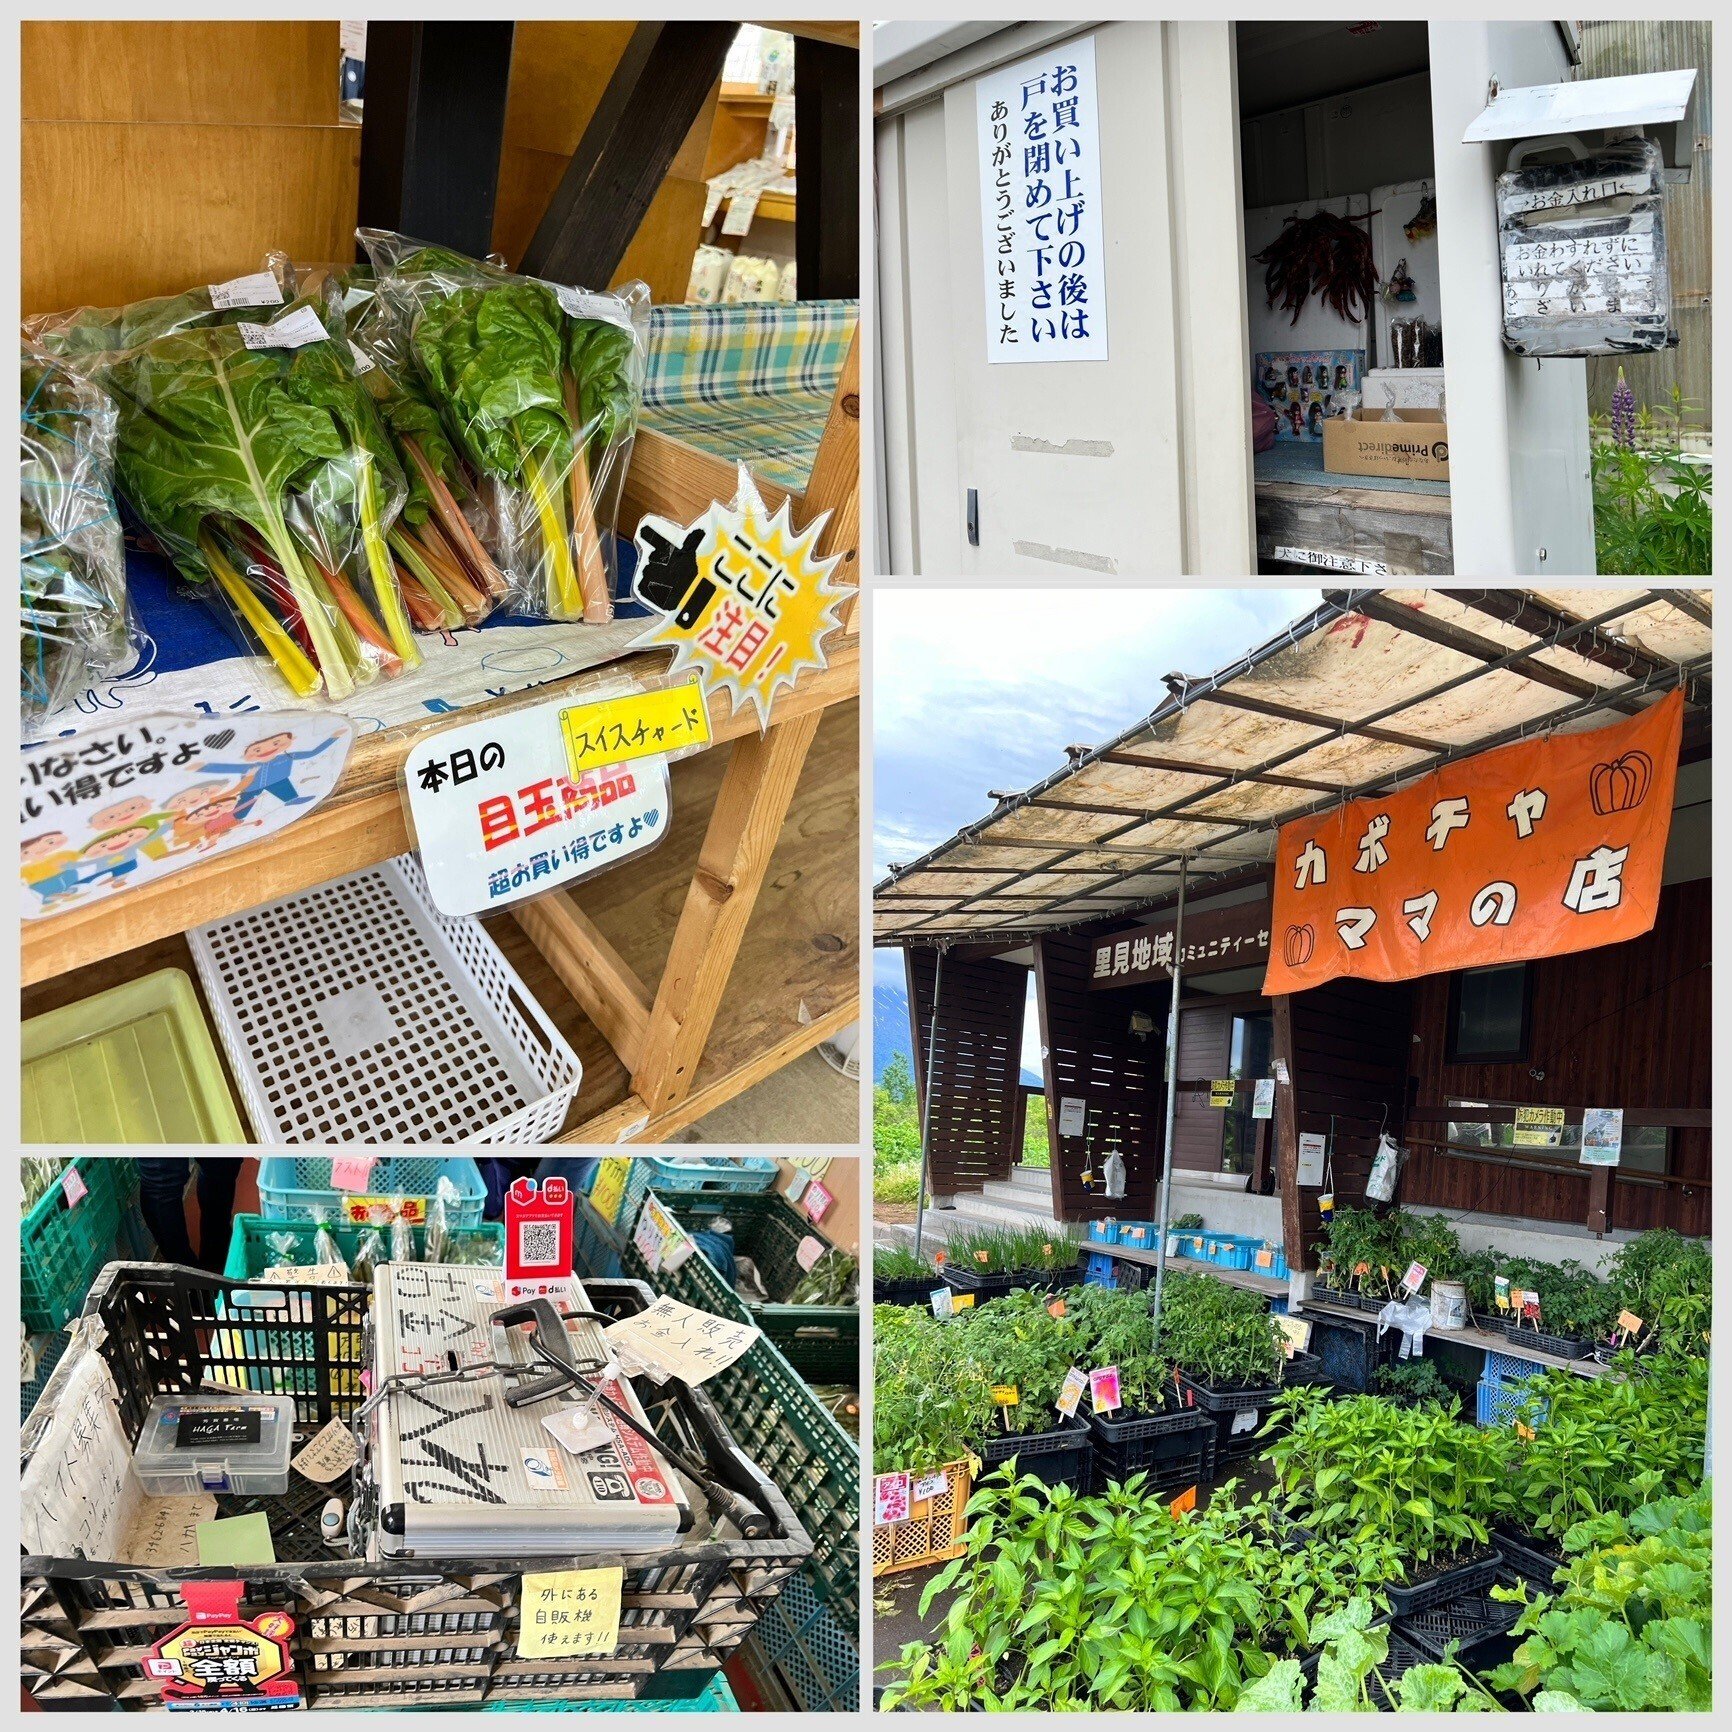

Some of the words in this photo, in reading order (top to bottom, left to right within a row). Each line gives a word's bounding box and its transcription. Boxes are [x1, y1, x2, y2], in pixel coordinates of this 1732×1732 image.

[1020, 72, 1056, 343] 戸を閉めて下さい
[1050, 65, 1090, 340] お買い上げの後は
[1532, 181, 1618, 208] お金入れ口
[991, 100, 1018, 344] ありがとうございました
[1515, 237, 1639, 261] お金わすれずに
[1519, 257, 1641, 278] いれてください
[1358, 442, 1428, 456] Primedirect
[713, 534, 796, 619] ここに
[575, 707, 700, 759] スイスチャード
[20, 740, 201, 824] い得ですよ
[417, 742, 505, 794] 本日の
[488, 816, 643, 899] 超お買い得ですよ
[1335, 844, 1631, 951] ママの店
[1093, 931, 1175, 979] 里見地域
[1516, 1108, 1563, 1124] 防犯カメラ作動中
[522, 1287, 536, 1296] Pay
[651, 1302, 746, 1350] 無人販売
[192, 1424, 220, 1434] HAGA
[593, 1478, 608, 1495] 110
[541, 1587, 598, 1602] 外にある
[536, 1608, 593, 1625] 自販機
[191, 1658, 258, 1676] 全額
